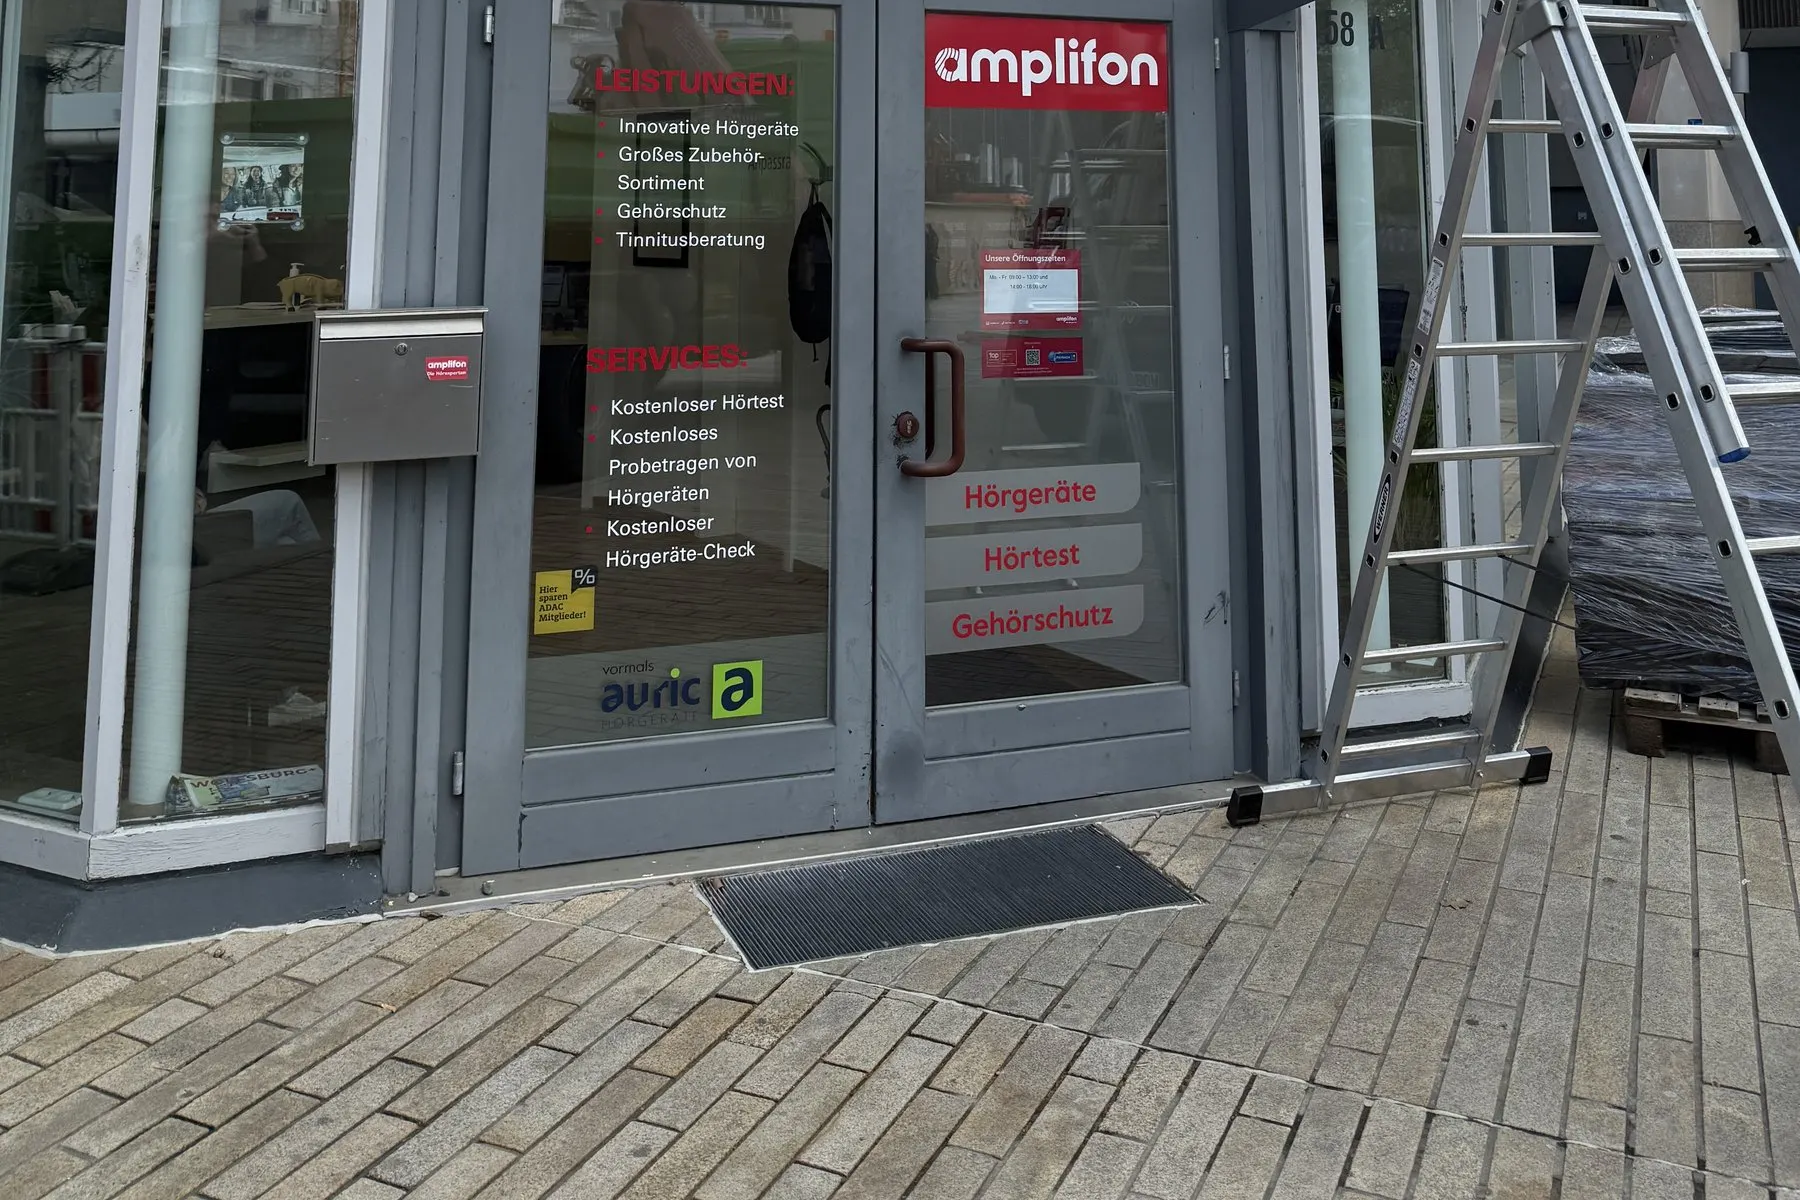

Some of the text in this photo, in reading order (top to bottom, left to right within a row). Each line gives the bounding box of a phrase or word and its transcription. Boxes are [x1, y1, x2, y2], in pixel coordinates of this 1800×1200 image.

[1325, 9, 1355, 47] 58
[934, 38, 1159, 97] amplifon
[594, 67, 796, 97] LEISTUNGEN:
[619, 117, 800, 139] Innovative Hörgeräte
[618, 146, 765, 164] Großes Zubehör-
[617, 174, 705, 191] Sortiment
[617, 203, 727, 220] Gehörschutz
[615, 231, 766, 250] Tinnitusberatung
[985, 253, 1066, 264] Unsere Öffnungszeiten
[427, 359, 467, 371] amplifon
[586, 343, 749, 375] SERVICES:
[611, 394, 784, 416] Kostenloser Hörtest
[610, 426, 718, 445] Kostenloses
[609, 455, 757, 477] Probetragen von
[608, 485, 710, 508] Hörgeräten
[965, 480, 1097, 513] Hörgeräte
[1376, 485, 1390, 530] WERNER
[607, 515, 714, 537] Kostenloser
[606, 541, 756, 569] Hörgeräte-Check
[984, 544, 1080, 572] Hörtest
[538, 593, 568, 604] sparen
[539, 585, 559, 594] Hier
[538, 603, 564, 612] ADAC
[538, 611, 587, 623] Mitglieder!
[951, 604, 1114, 639] Gehörschutz
[602, 659, 655, 676] vormals
[601, 667, 701, 714] auric
